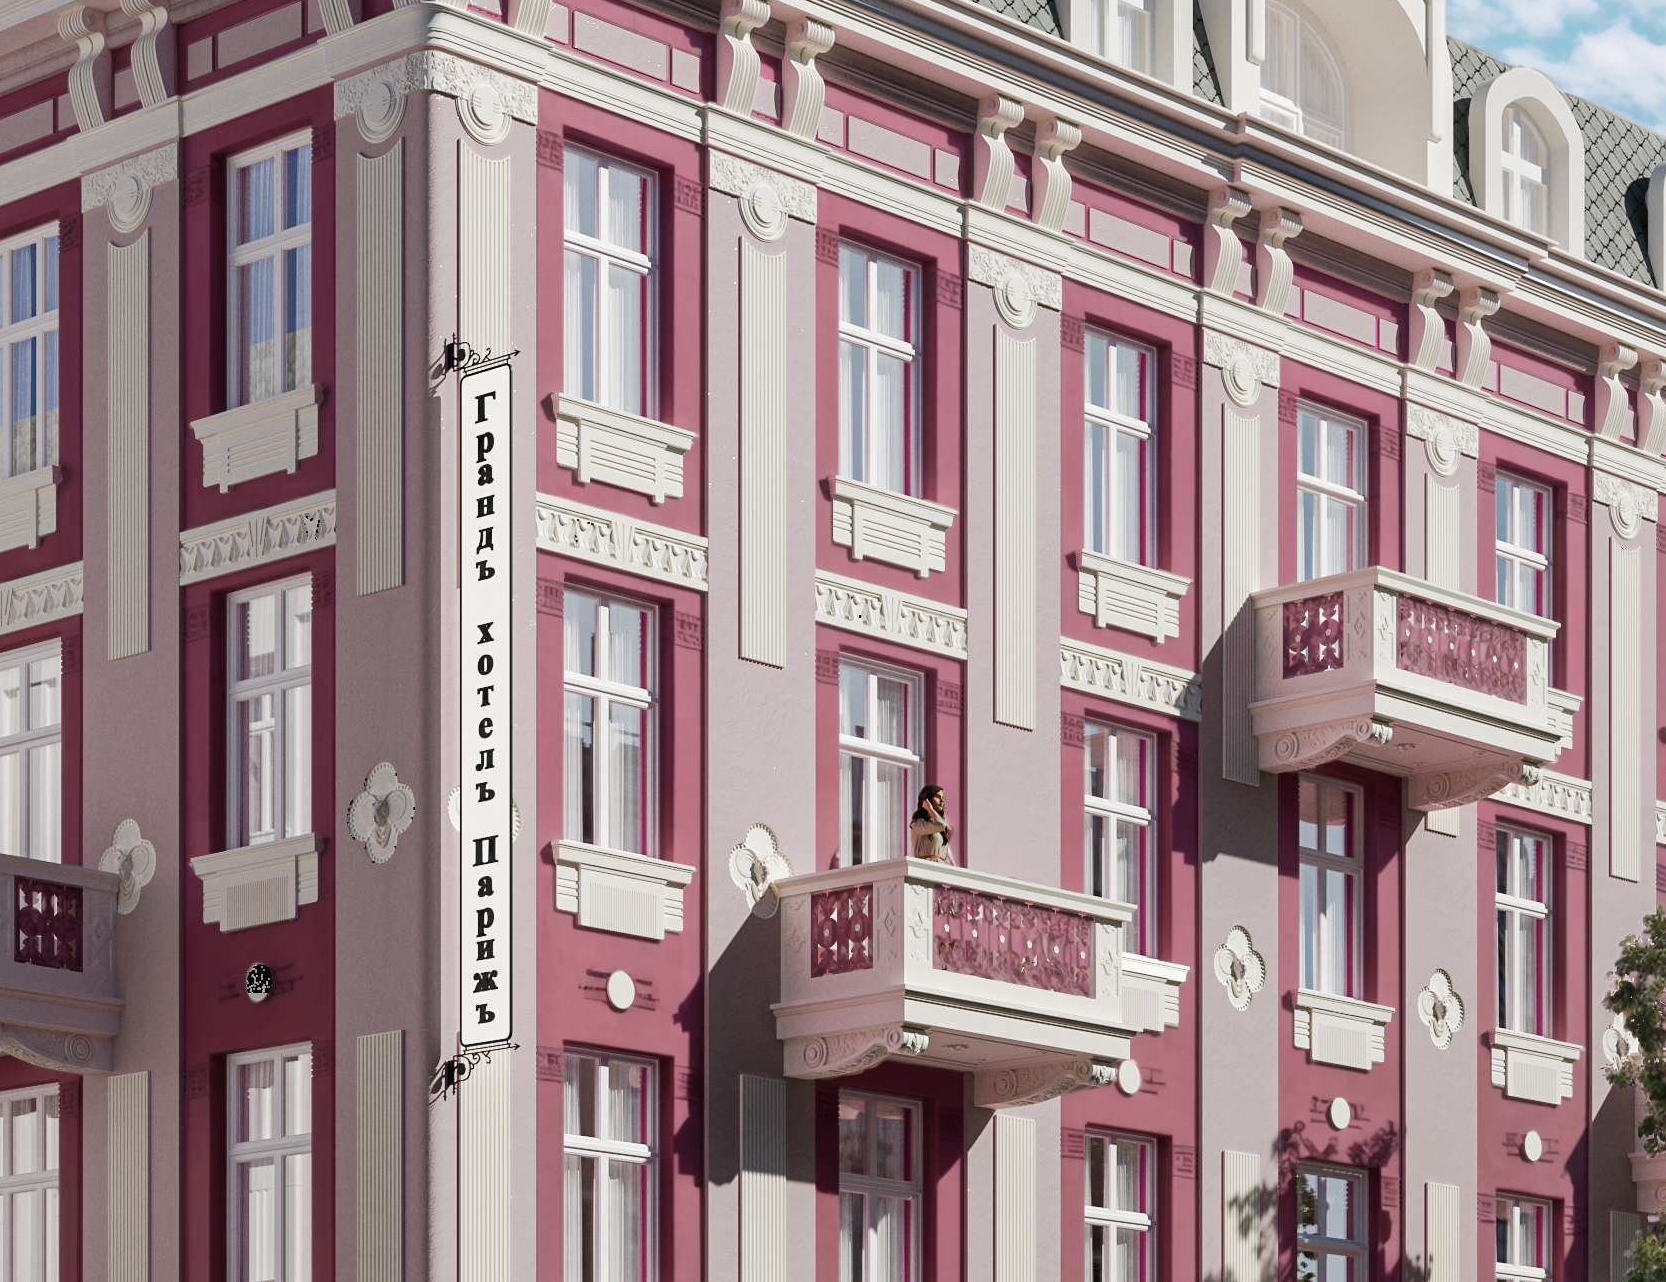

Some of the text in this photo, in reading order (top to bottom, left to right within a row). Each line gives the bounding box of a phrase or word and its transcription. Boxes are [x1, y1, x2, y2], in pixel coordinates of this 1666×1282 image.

[471, 390, 500, 1025] Грандъ хотелъ Парижъ
